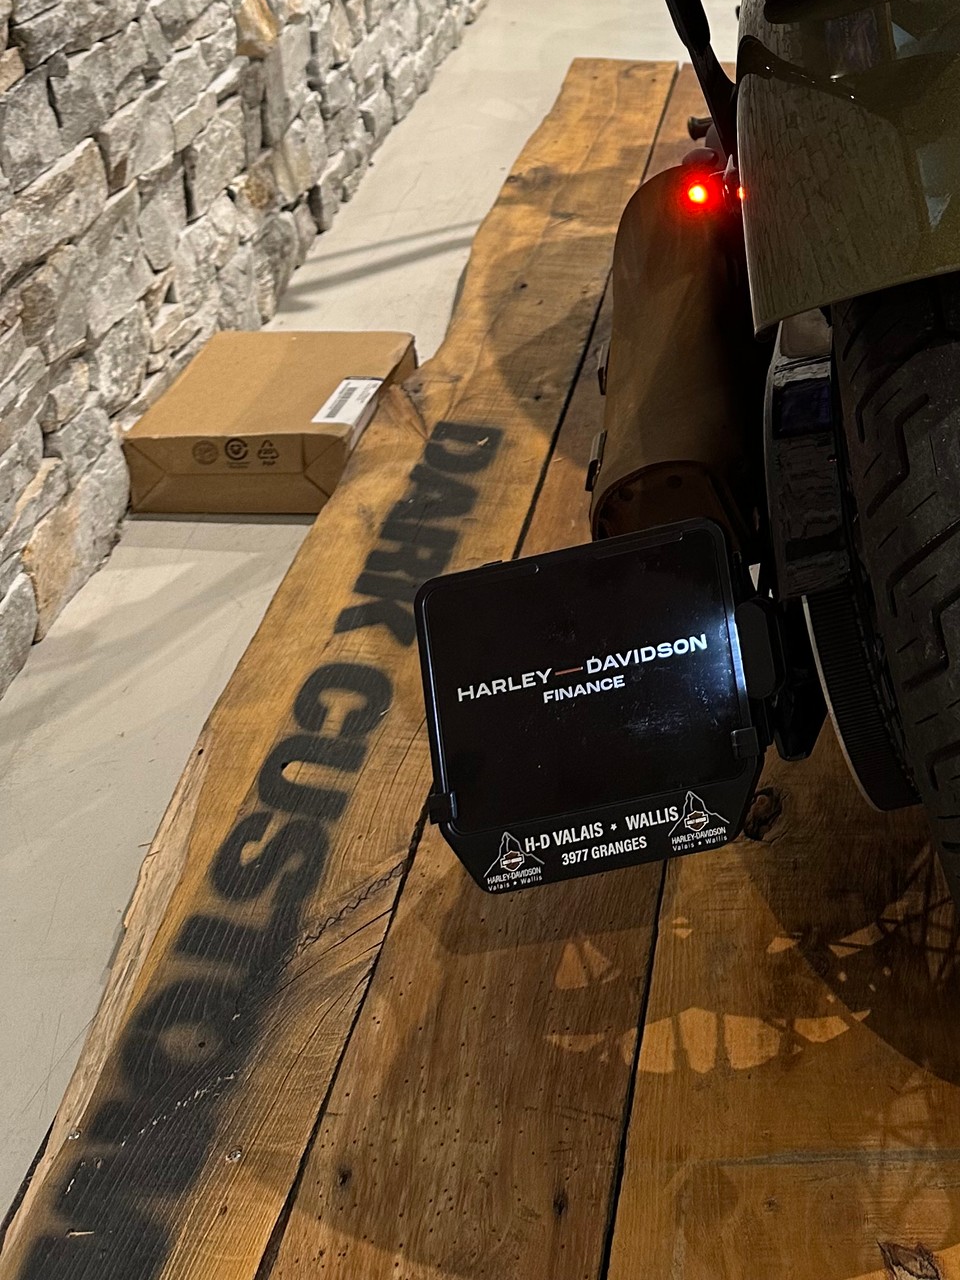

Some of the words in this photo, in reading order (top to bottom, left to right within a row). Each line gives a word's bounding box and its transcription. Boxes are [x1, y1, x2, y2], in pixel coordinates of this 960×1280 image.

[332, 420, 505, 648] DARK
[543, 674, 626, 704] FINANCE
[524, 833, 551, 853] H-D
[552, 821, 604, 847] VALAIS
[625, 805, 680, 831] WALLIS
[672, 842, 695, 852] Valais
[705, 835, 728, 845] Wallis
[561, 847, 589, 866] 3977
[591, 835, 648, 860] GRANGES
[488, 881, 510, 892] Valais
[520, 875, 543, 885] Wallis
